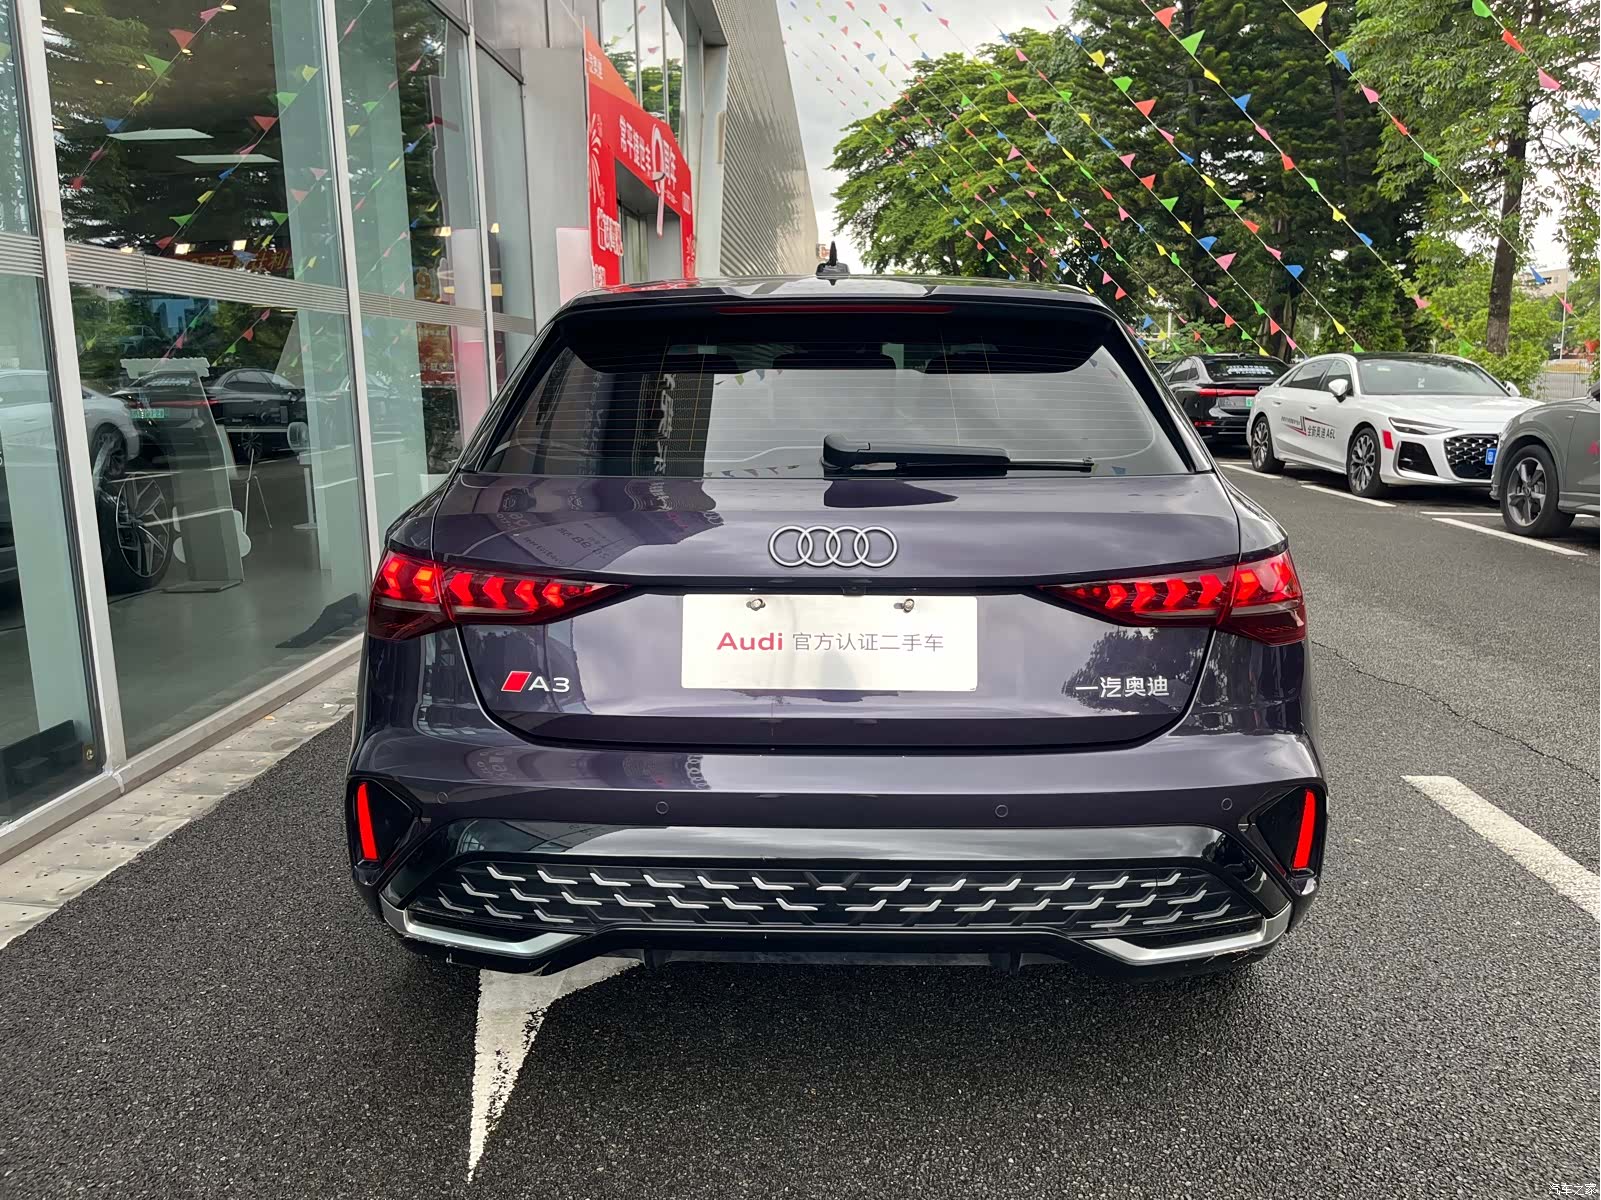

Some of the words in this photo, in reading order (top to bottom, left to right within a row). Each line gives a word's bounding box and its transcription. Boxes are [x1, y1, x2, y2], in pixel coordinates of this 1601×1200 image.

[716, 632, 783, 651] Audi
[792, 632, 944, 652] 官方认证二手车
[528, 676, 570, 693] A3
[1075, 675, 1170, 698] 一汽奥迪
